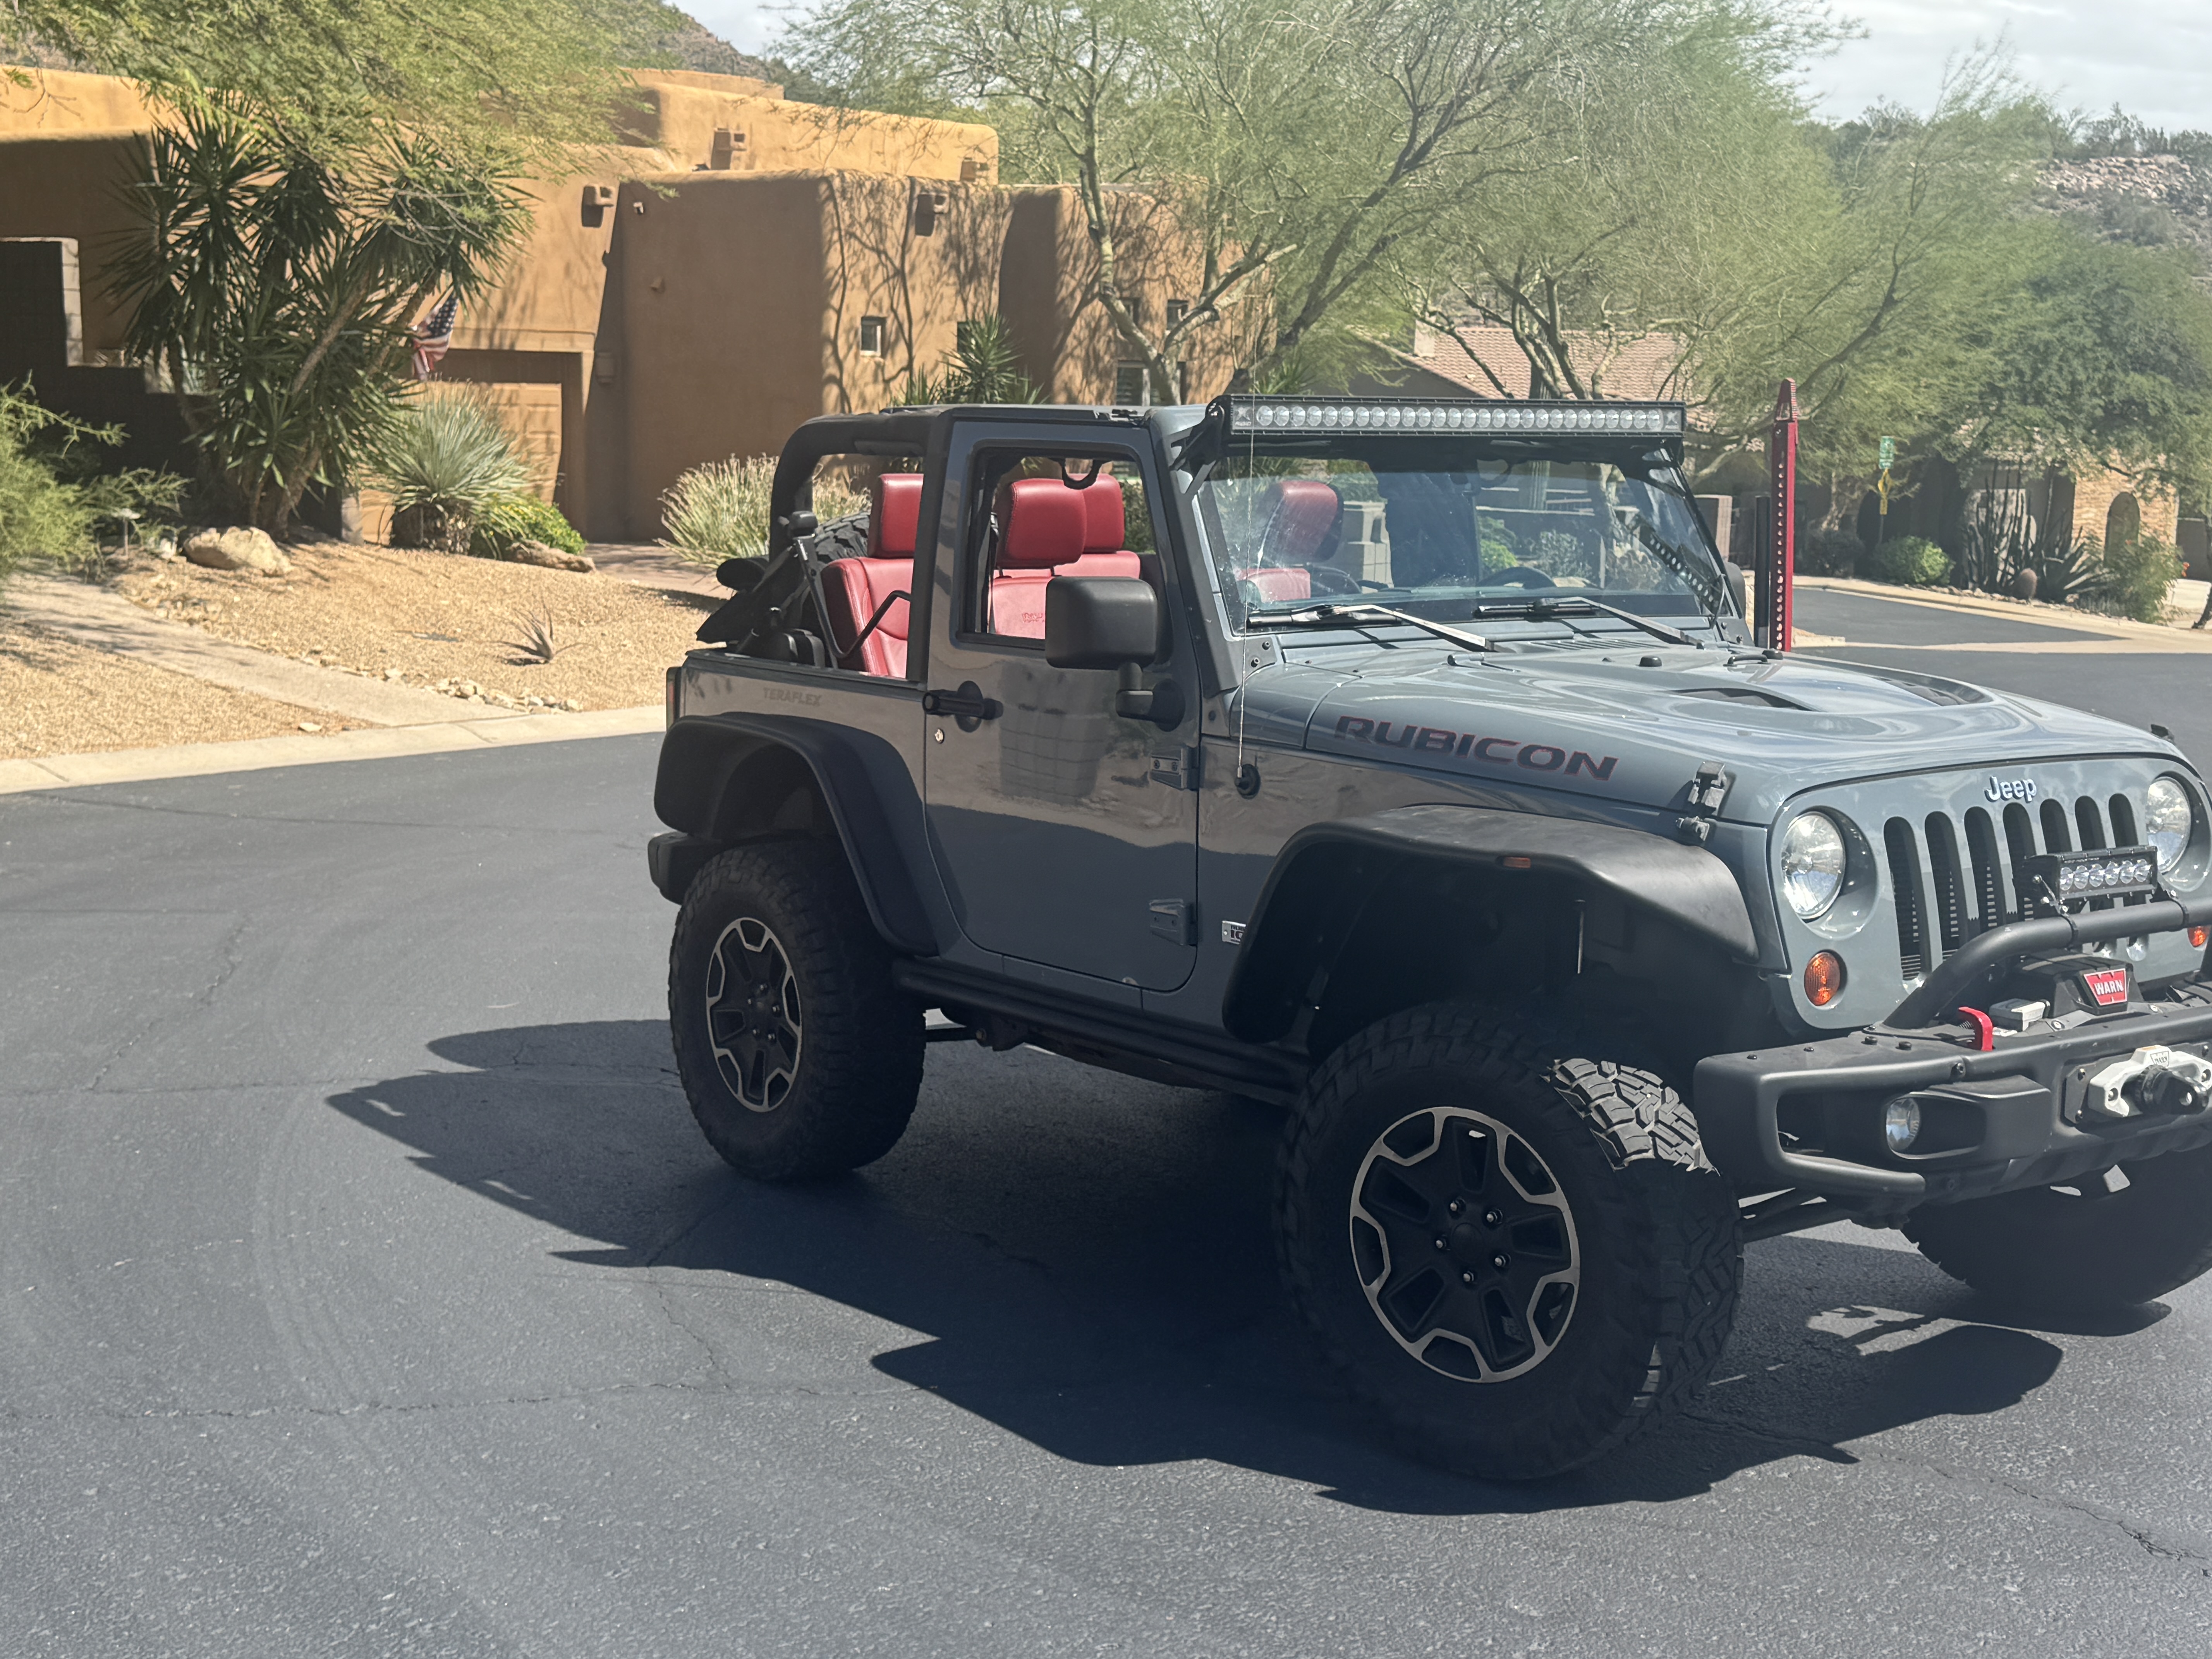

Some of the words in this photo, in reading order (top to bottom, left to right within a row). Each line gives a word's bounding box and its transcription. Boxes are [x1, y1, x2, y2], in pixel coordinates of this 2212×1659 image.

[763, 687, 822, 707] TERAFLEX
[1334, 715, 1620, 781] RUBICON
[1984, 776, 2037, 803] Jeep
[2094, 979, 2124, 995] WARN
